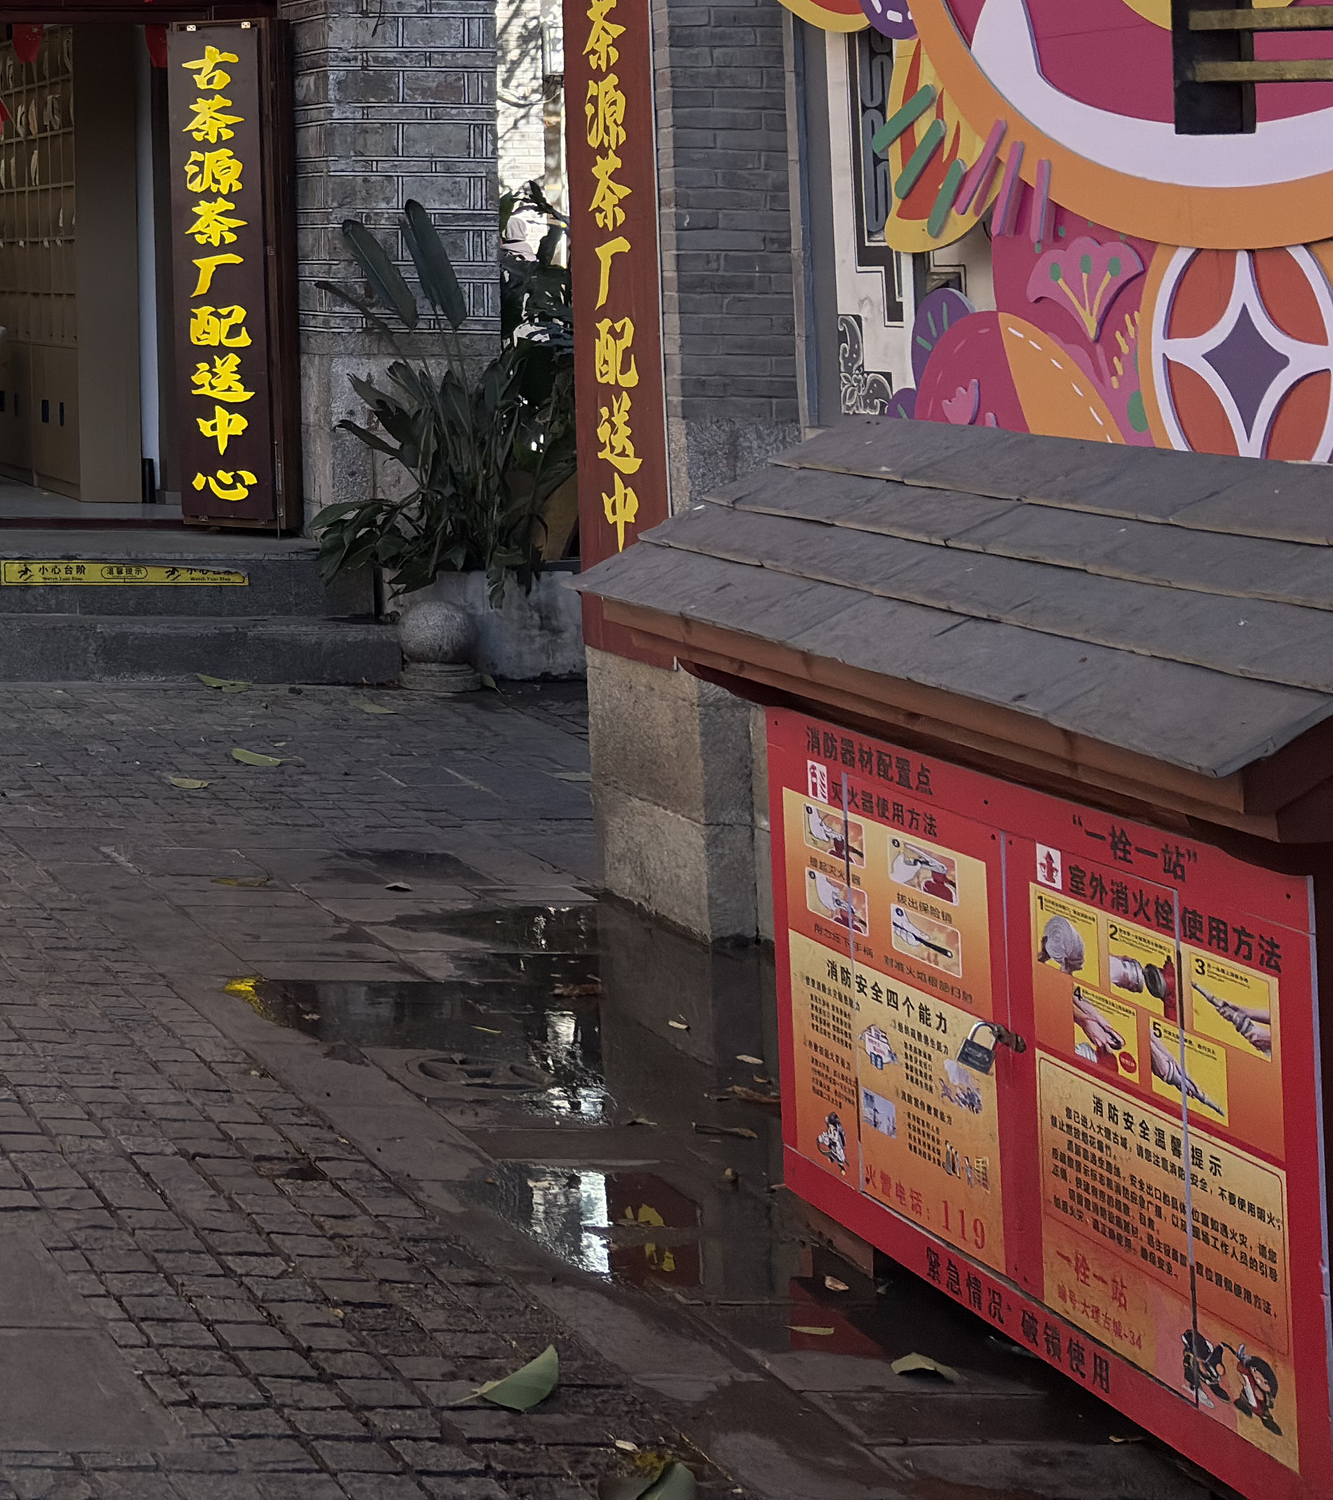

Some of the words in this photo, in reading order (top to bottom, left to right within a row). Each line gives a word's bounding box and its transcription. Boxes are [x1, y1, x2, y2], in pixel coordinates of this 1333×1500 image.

[182, 45, 258, 502] 古茶源茶厂配送中心
[38, 565, 86, 575] 小心台阶
[806, 725, 933, 796] 消防器材配置点
[831, 781, 938, 837] 灭火器使用方法
[1037, 895, 1044, 911] 1
[1068, 864, 1282, 973] 室外消火栓使用方法
[1109, 924, 1119, 941] 2
[1195, 958, 1206, 976] 3
[826, 959, 947, 1034] 消防安全四个能力
[1073, 986, 1082, 1001] 4
[1152, 1022, 1163, 1038] 5
[1093, 1095, 1222, 1177] 消防安全温馨提示
[942, 1200, 986, 1250] 119
